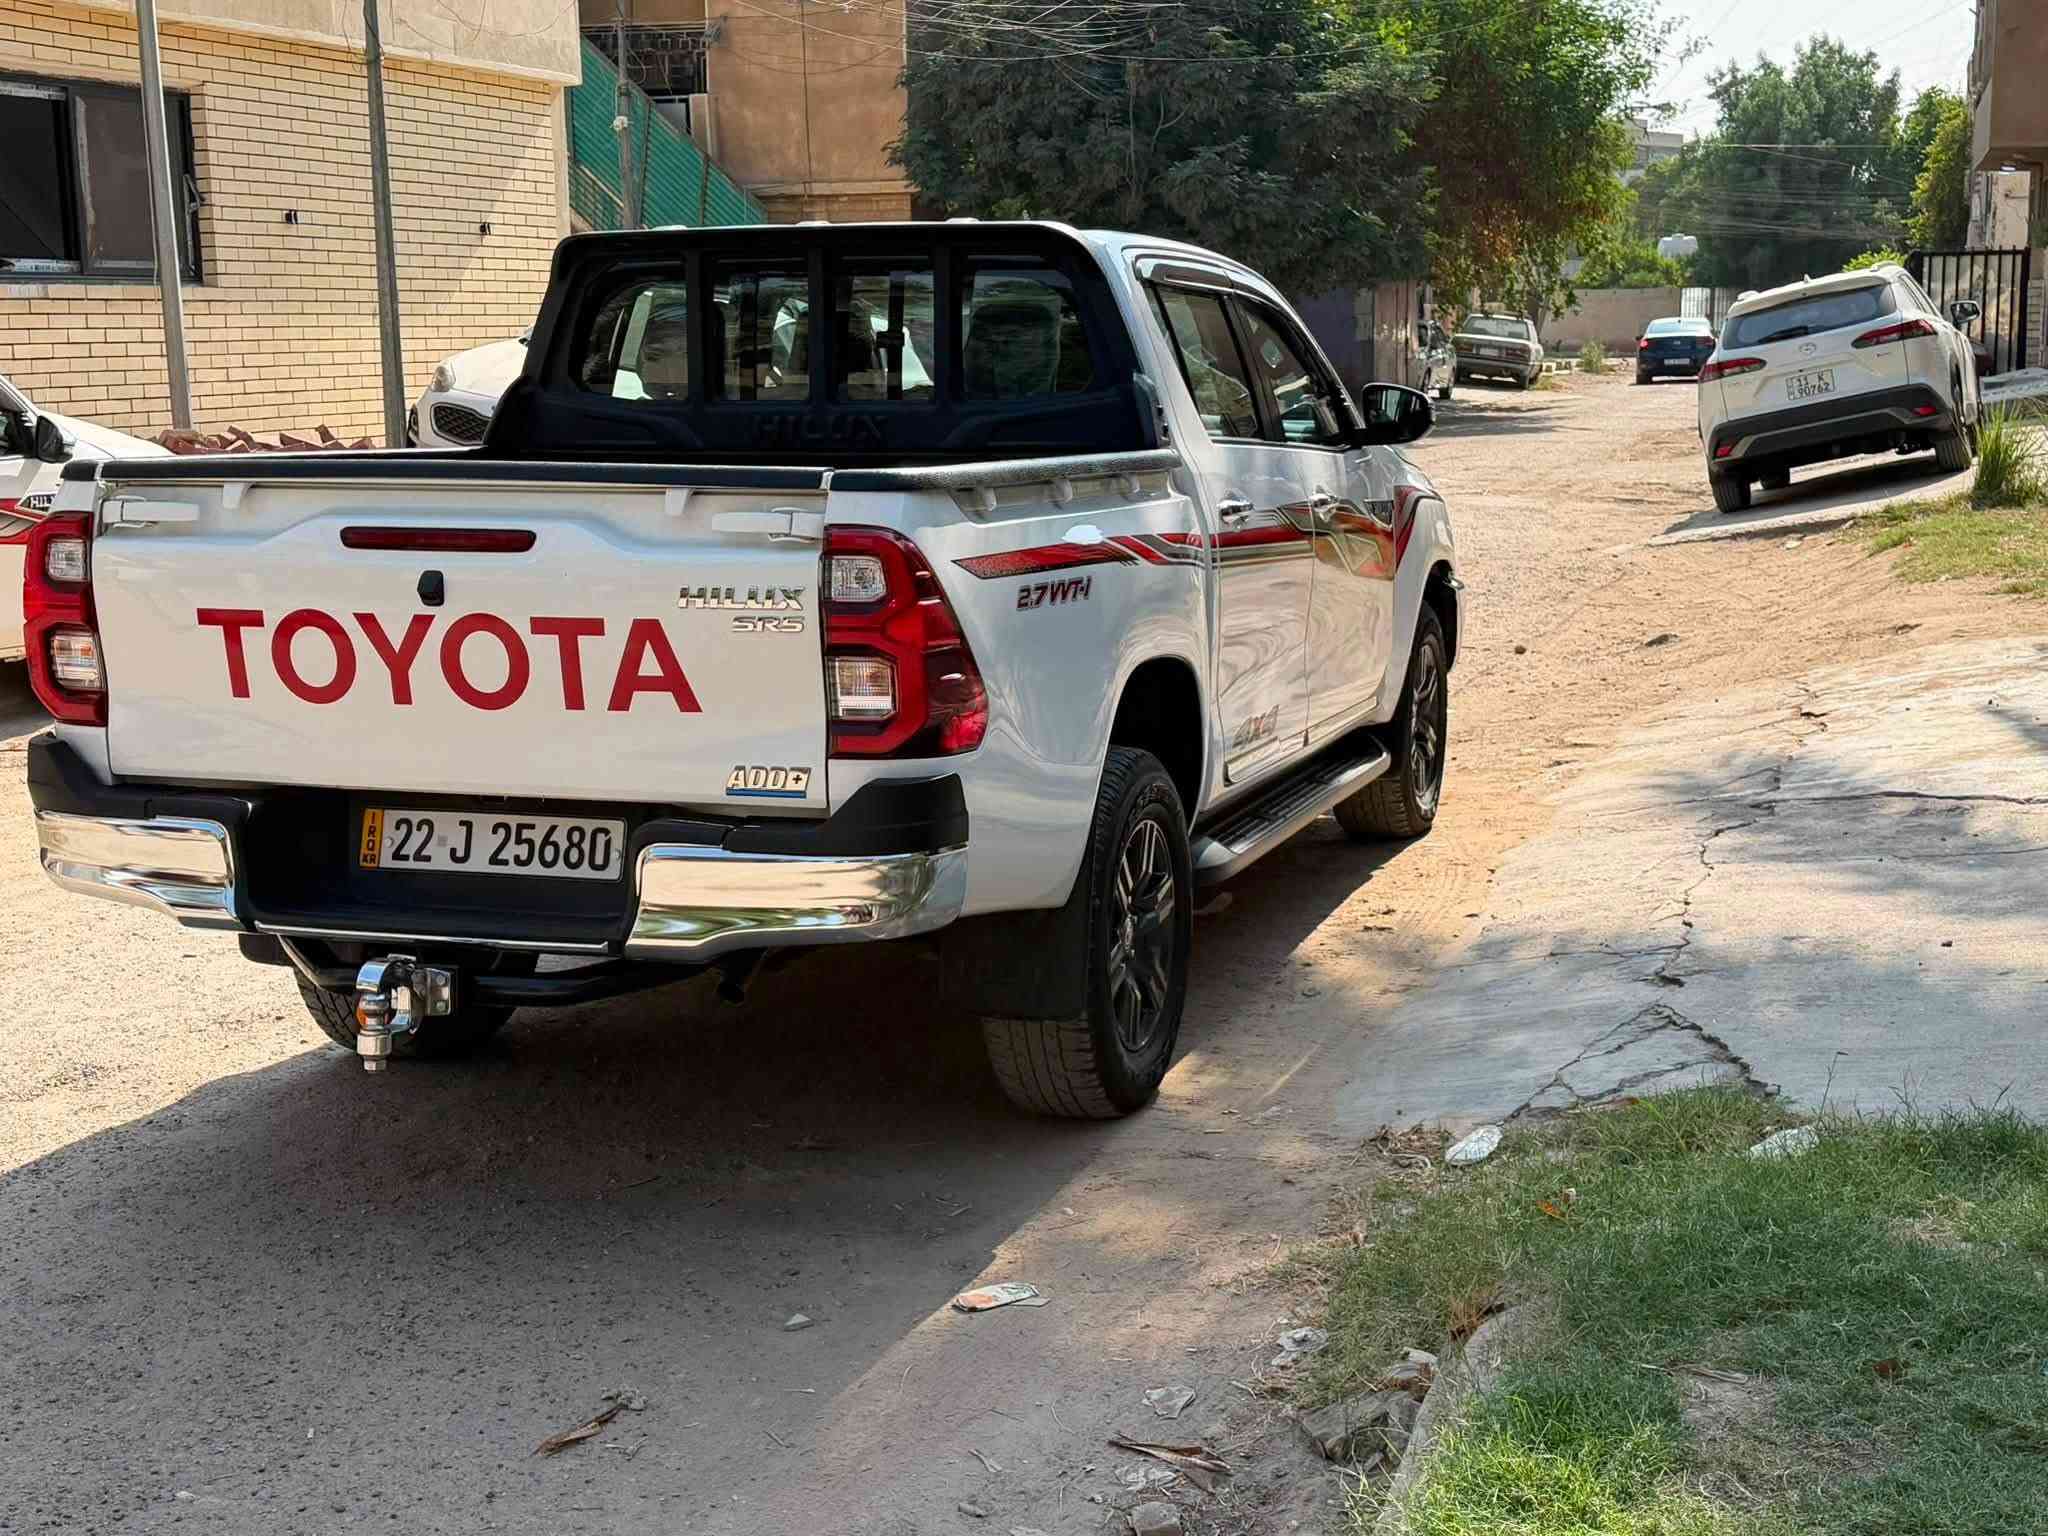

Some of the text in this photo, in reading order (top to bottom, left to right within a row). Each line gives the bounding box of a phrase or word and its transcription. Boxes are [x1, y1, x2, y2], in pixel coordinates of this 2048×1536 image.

[756, 414, 888, 440] HILUX
[31, 495, 55, 508] HIL
[678, 585, 804, 611] HILUX
[197, 608, 704, 714] TOYOTA
[391, 818, 611, 871] 22 J 25680
